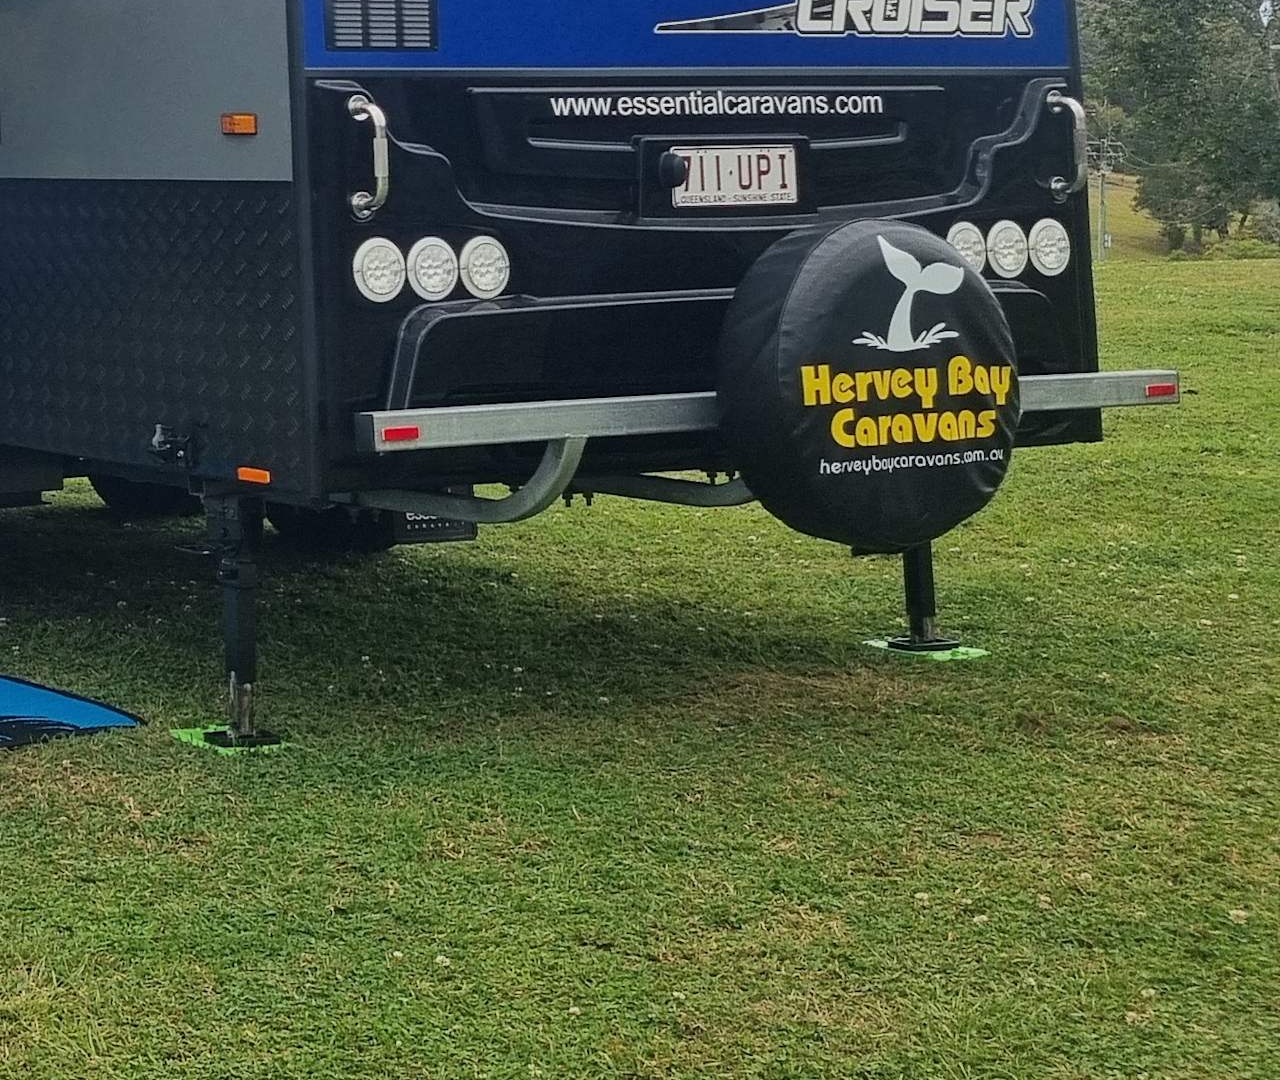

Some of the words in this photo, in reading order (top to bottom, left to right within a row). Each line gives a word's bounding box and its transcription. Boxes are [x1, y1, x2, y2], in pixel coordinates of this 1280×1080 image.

[550, 90, 883, 117] www.essentialcaravans.com
[680, 195, 726, 204] QUEENSLAND
[733, 193, 768, 202] SUNSHINE
[770, 192, 792, 201] STATE
[801, 365, 938, 408] Hervey
[948, 355, 1011, 406] Bay
[831, 409, 997, 448] Caravans
[820, 448, 1003, 475] herveybaycaravans.com.au
